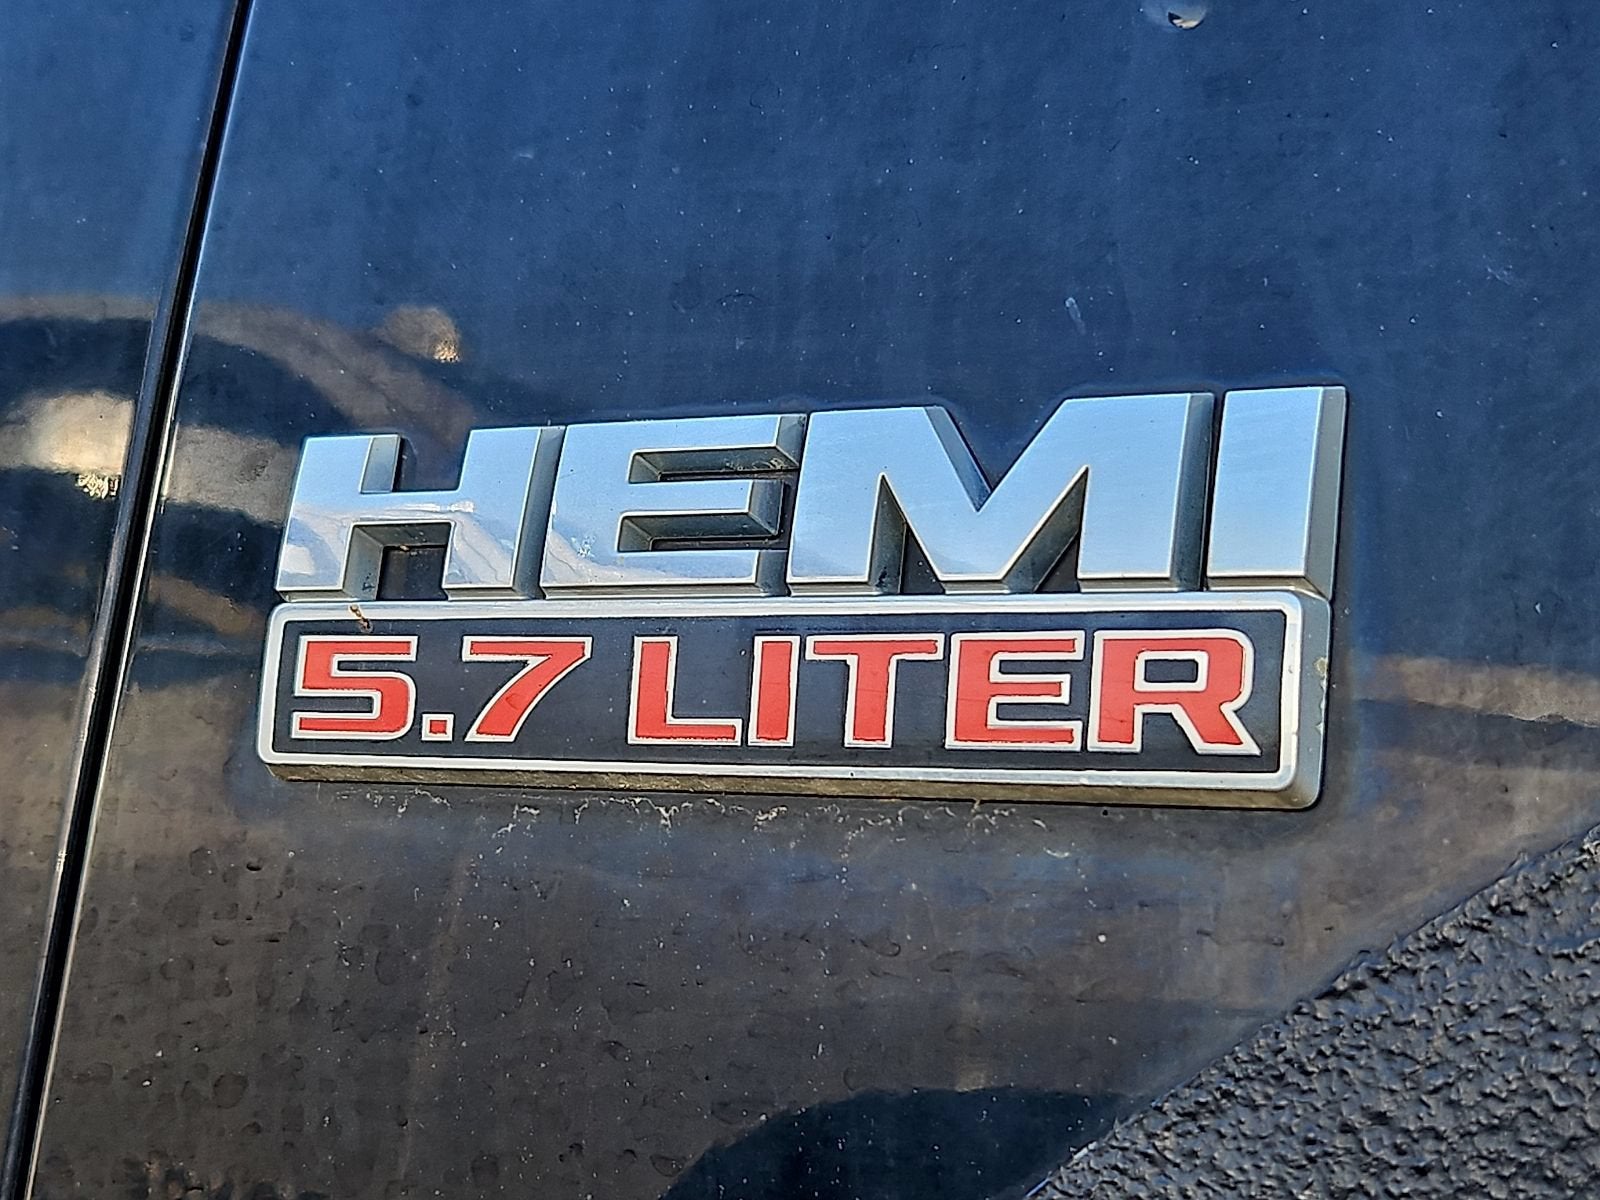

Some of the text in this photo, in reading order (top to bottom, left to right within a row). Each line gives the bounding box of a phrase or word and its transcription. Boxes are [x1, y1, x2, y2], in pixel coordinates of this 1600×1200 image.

[275, 386, 1347, 600] HEMI
[291, 628, 1262, 755] 5.7 LITER
